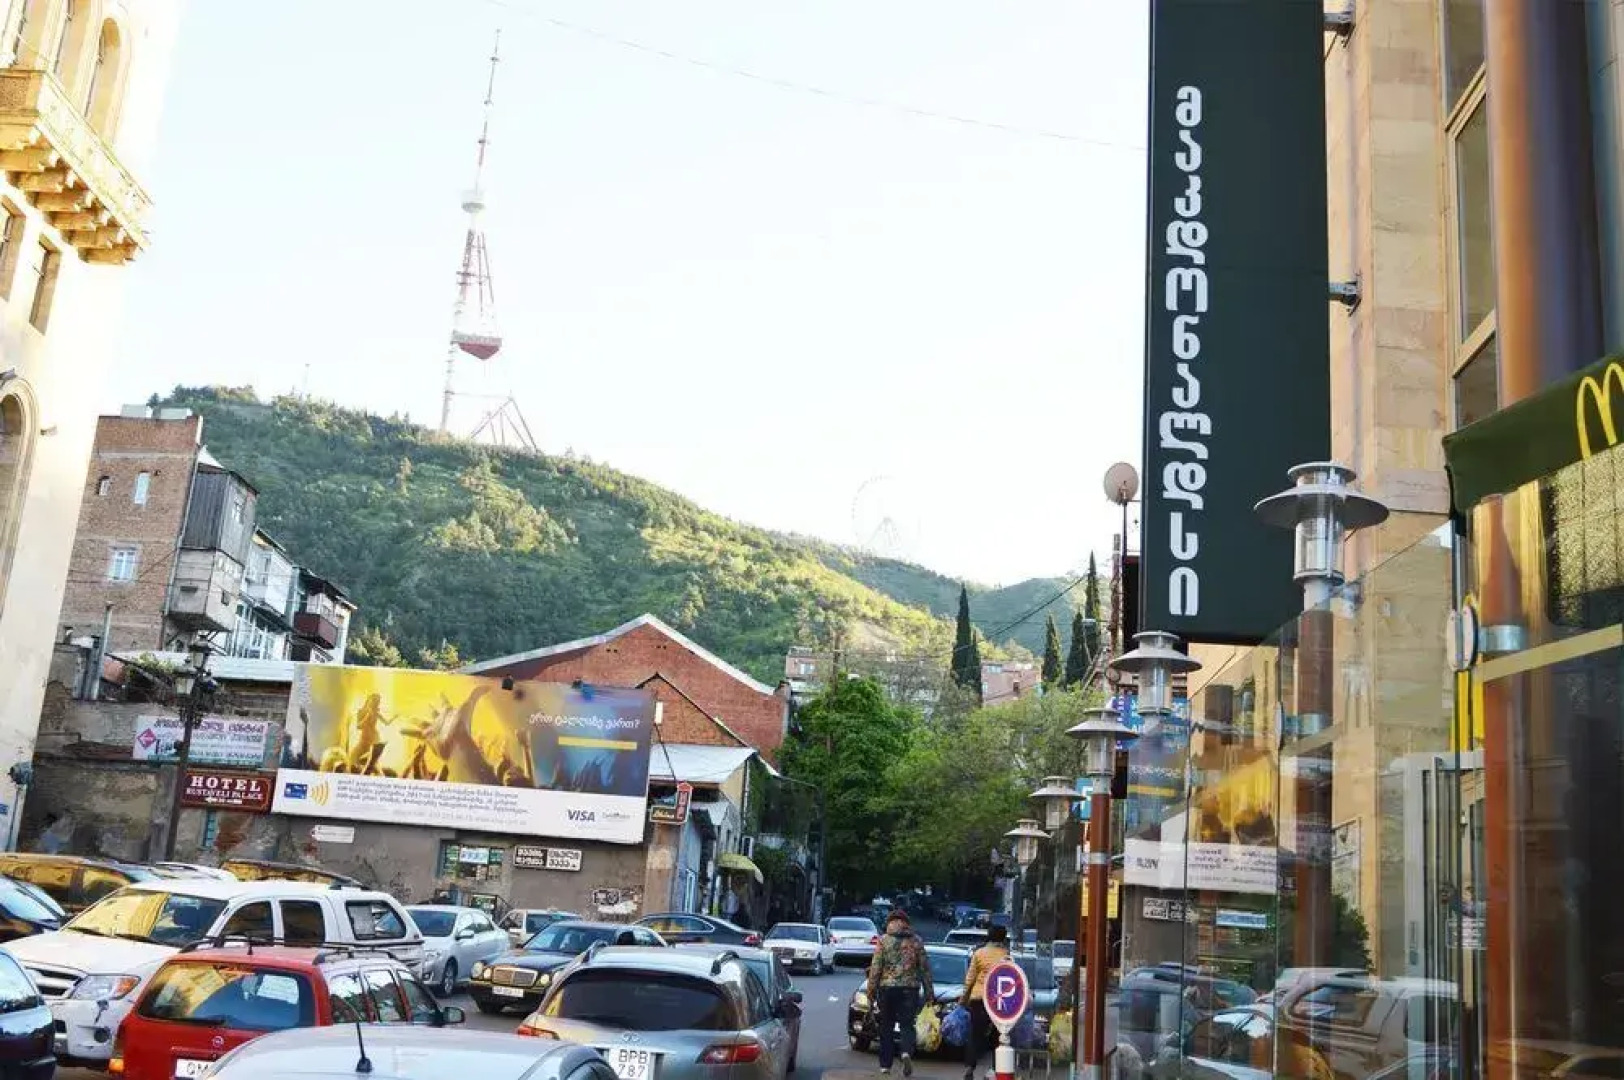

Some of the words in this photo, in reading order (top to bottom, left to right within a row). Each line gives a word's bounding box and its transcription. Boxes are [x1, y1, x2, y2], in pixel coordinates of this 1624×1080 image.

[1159, 85, 1212, 617] მაკდონალდსი
[190, 775, 261, 792] HOTEL
[567, 808, 596, 823] VISA
[996, 975, 1016, 1011] P
[618, 1048, 649, 1064] BPB
[618, 1063, 646, 1078] 787
